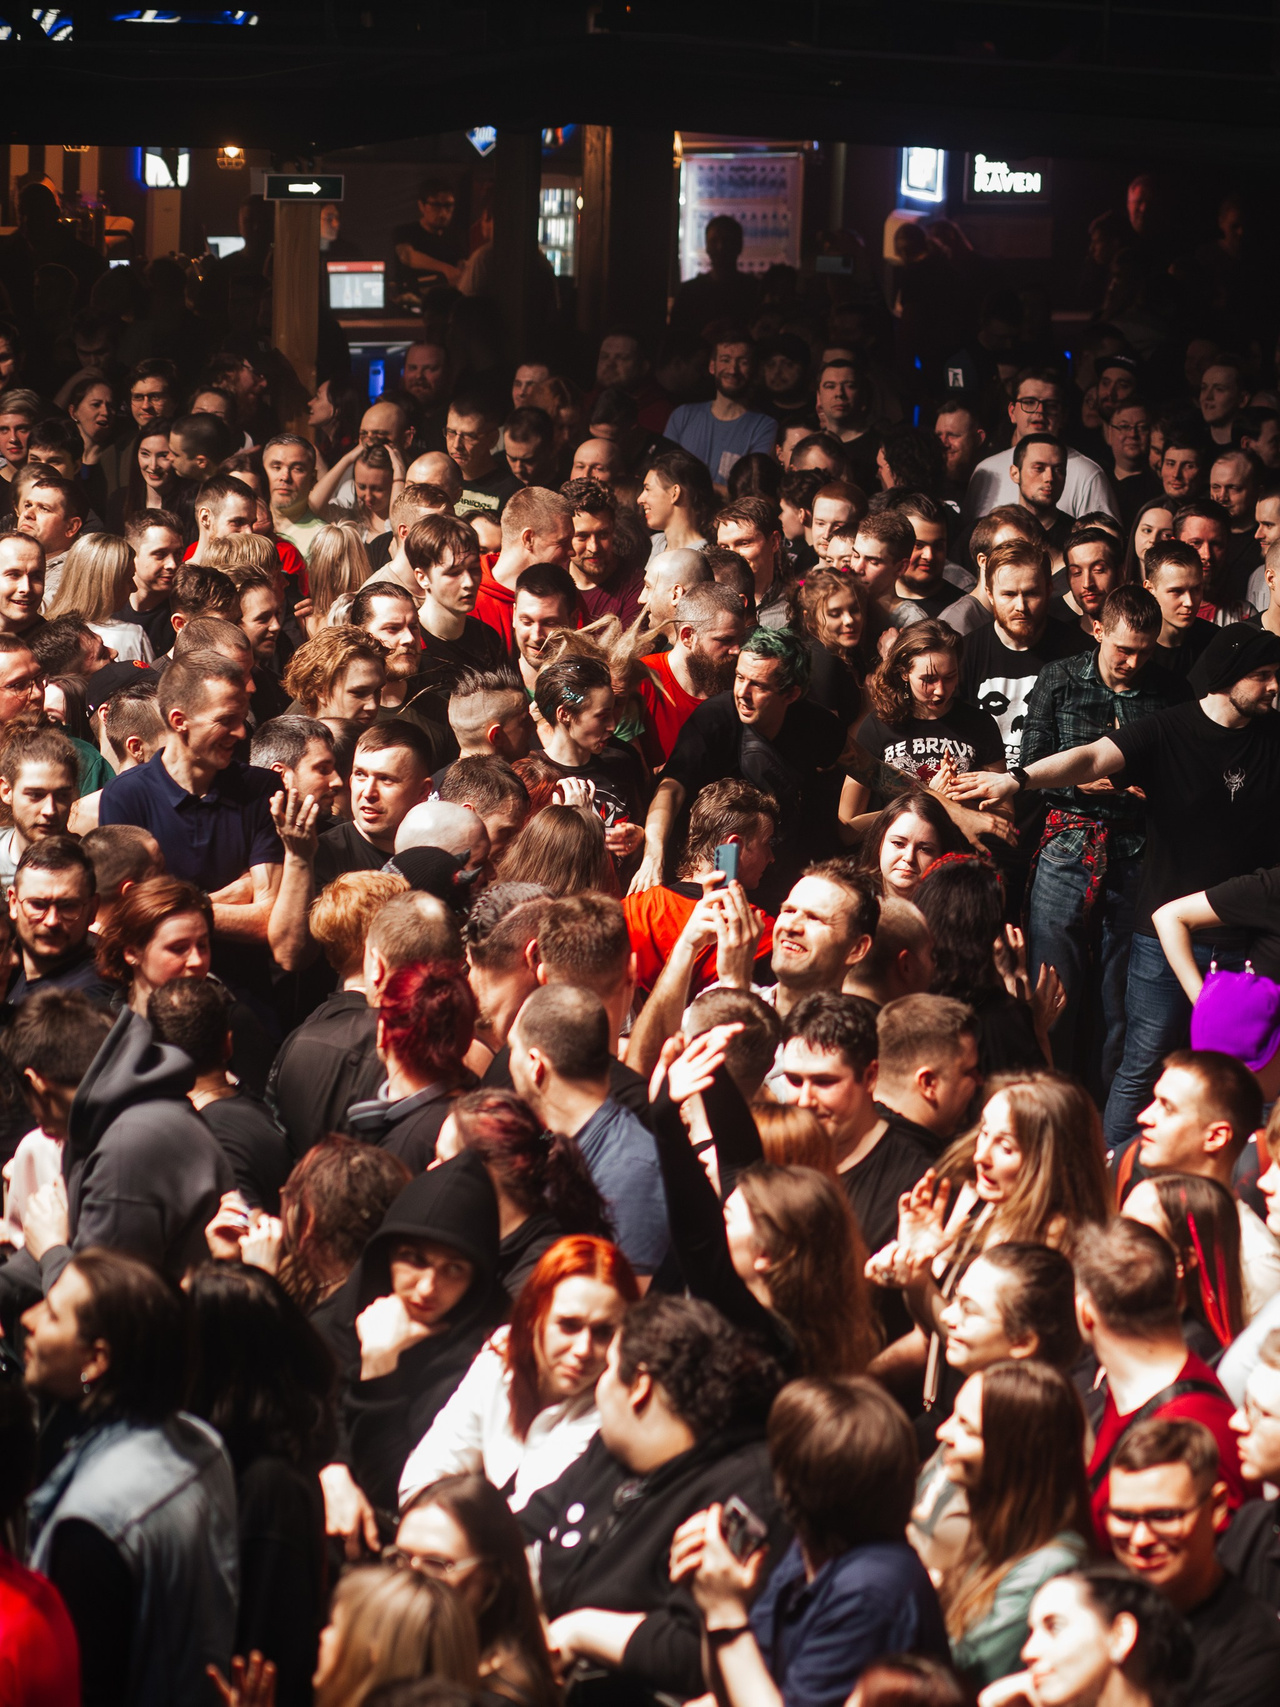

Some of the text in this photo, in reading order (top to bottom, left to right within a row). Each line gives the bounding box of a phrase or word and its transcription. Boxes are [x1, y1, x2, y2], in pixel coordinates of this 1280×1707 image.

[974, 172, 1041, 193] RAVEN
[884, 737, 977, 763] BE BRAVE
